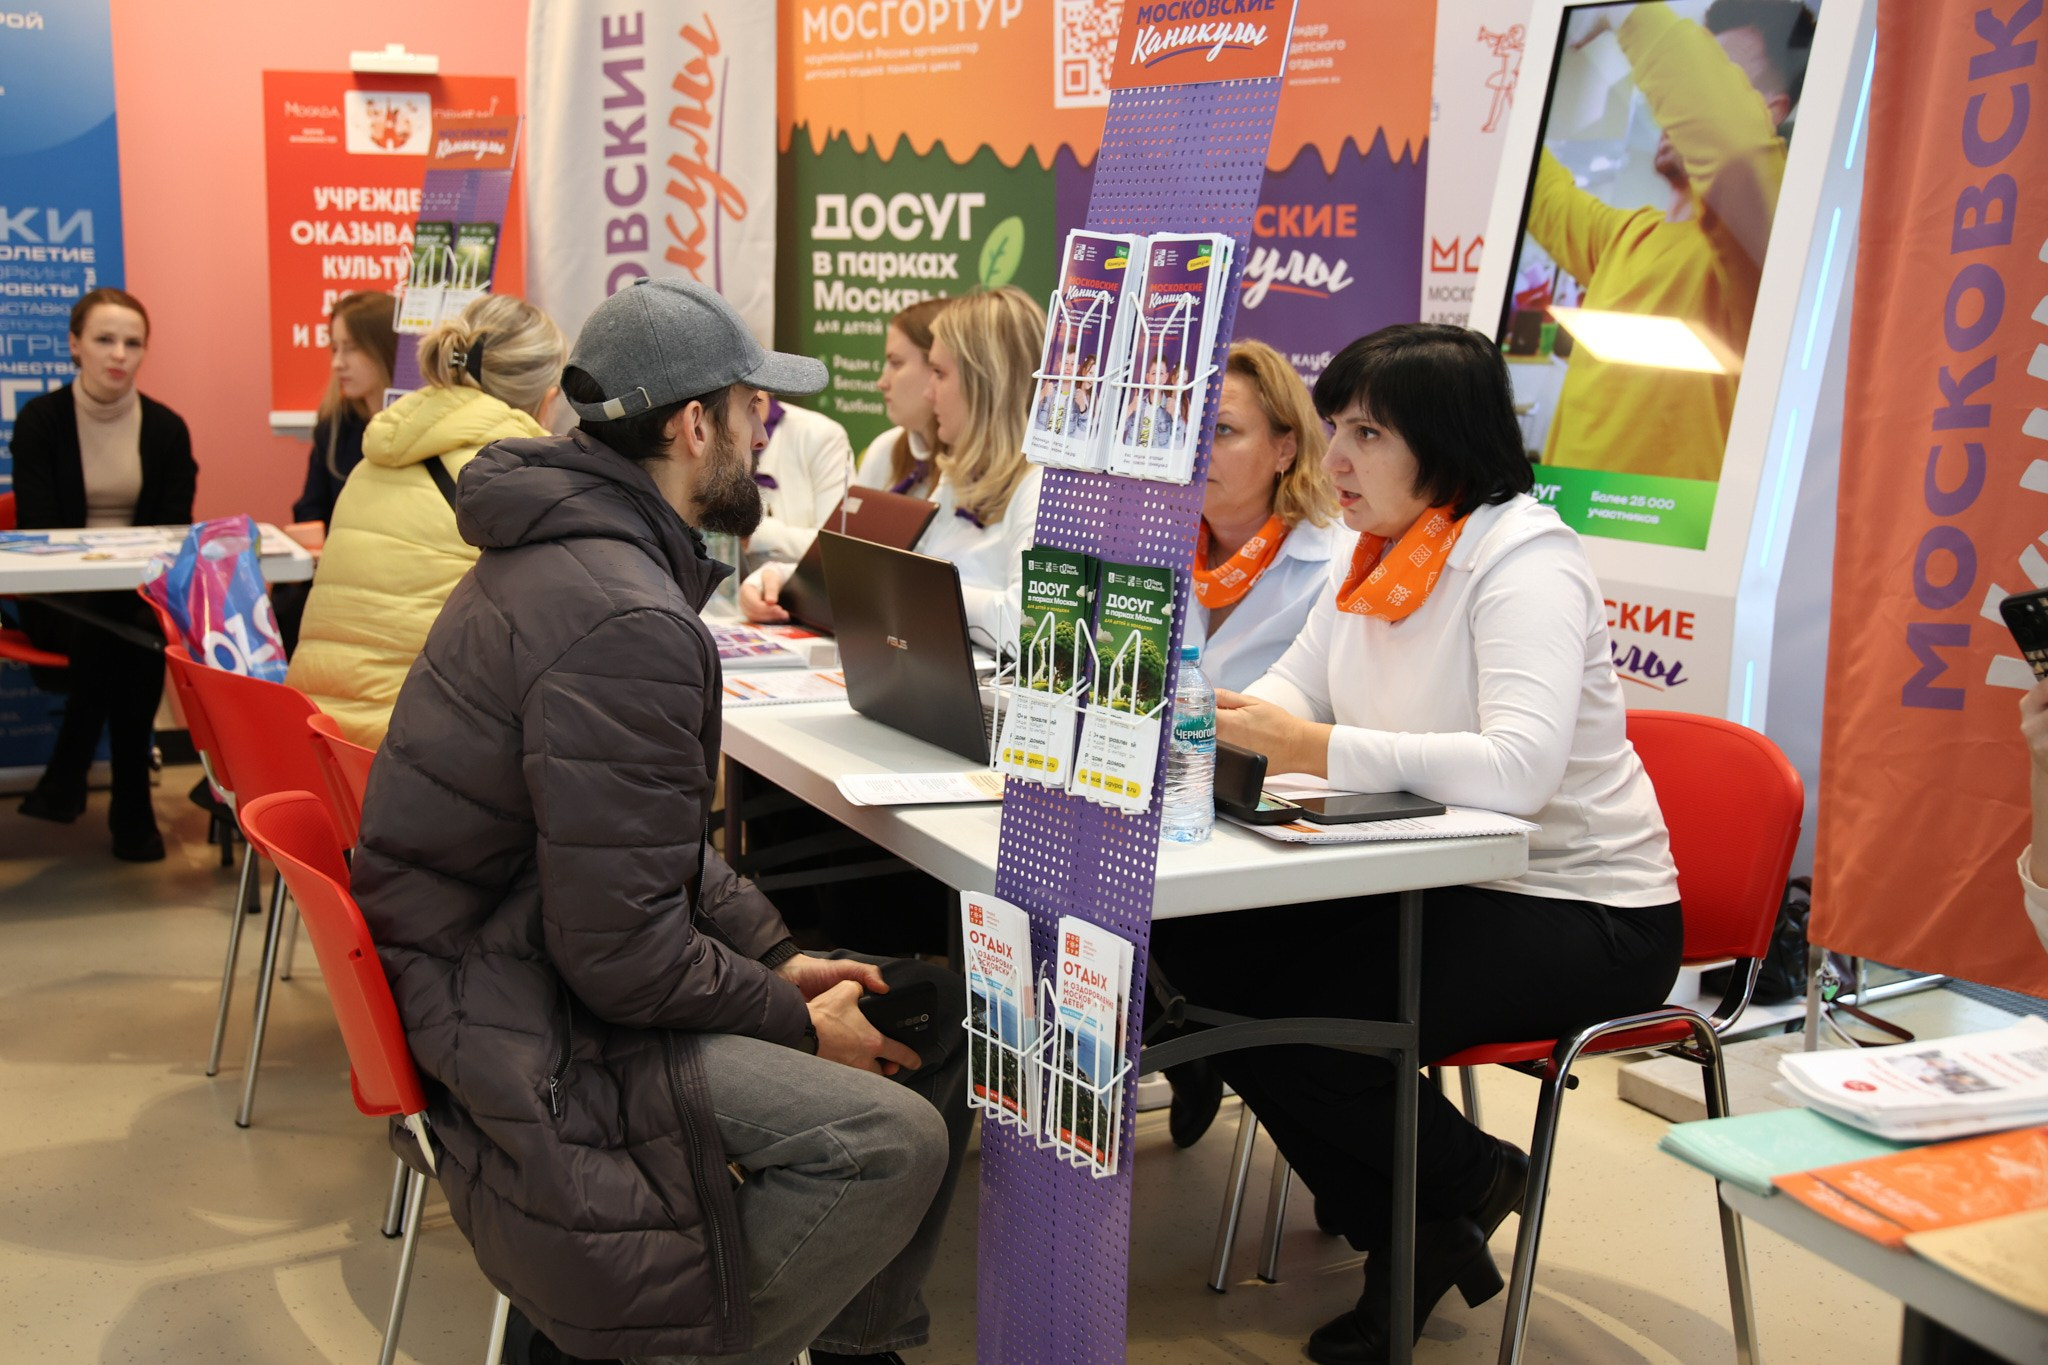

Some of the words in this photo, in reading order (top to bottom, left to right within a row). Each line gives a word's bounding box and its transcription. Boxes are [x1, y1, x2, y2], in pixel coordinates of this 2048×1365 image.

[802, 0, 1022, 45] МОСГОРТУР
[1136, 0, 1276, 26] МОСКОВСКИЕ
[1130, 22, 1269, 65] Каникулы
[811, 192, 987, 242] ДОСУГ
[812, 251, 833, 276] в
[836, 252, 959, 284] парках
[1065, 285, 1116, 305] Каникы
[1150, 283, 1204, 292] МОСКОВСКИЕ
[1291, 350, 1336, 371] клуб
[1900, 0, 2044, 711] МОСКОВСК
[1590, 490, 1628, 506] Более
[1647, 497, 1676, 511] 000
[1586, 507, 1661, 525] участников
[1027, 580, 1070, 597] ДОСУГ
[1053, 597, 1079, 607] Москвы
[1105, 593, 1155, 615] ДОСУГ
[1134, 612, 1163, 625] Москвы
[969, 930, 1013, 960] ОТДЫХ
[971, 963, 993, 977] ДТЕЙ
[1063, 960, 1108, 992] ОТДЫХ
